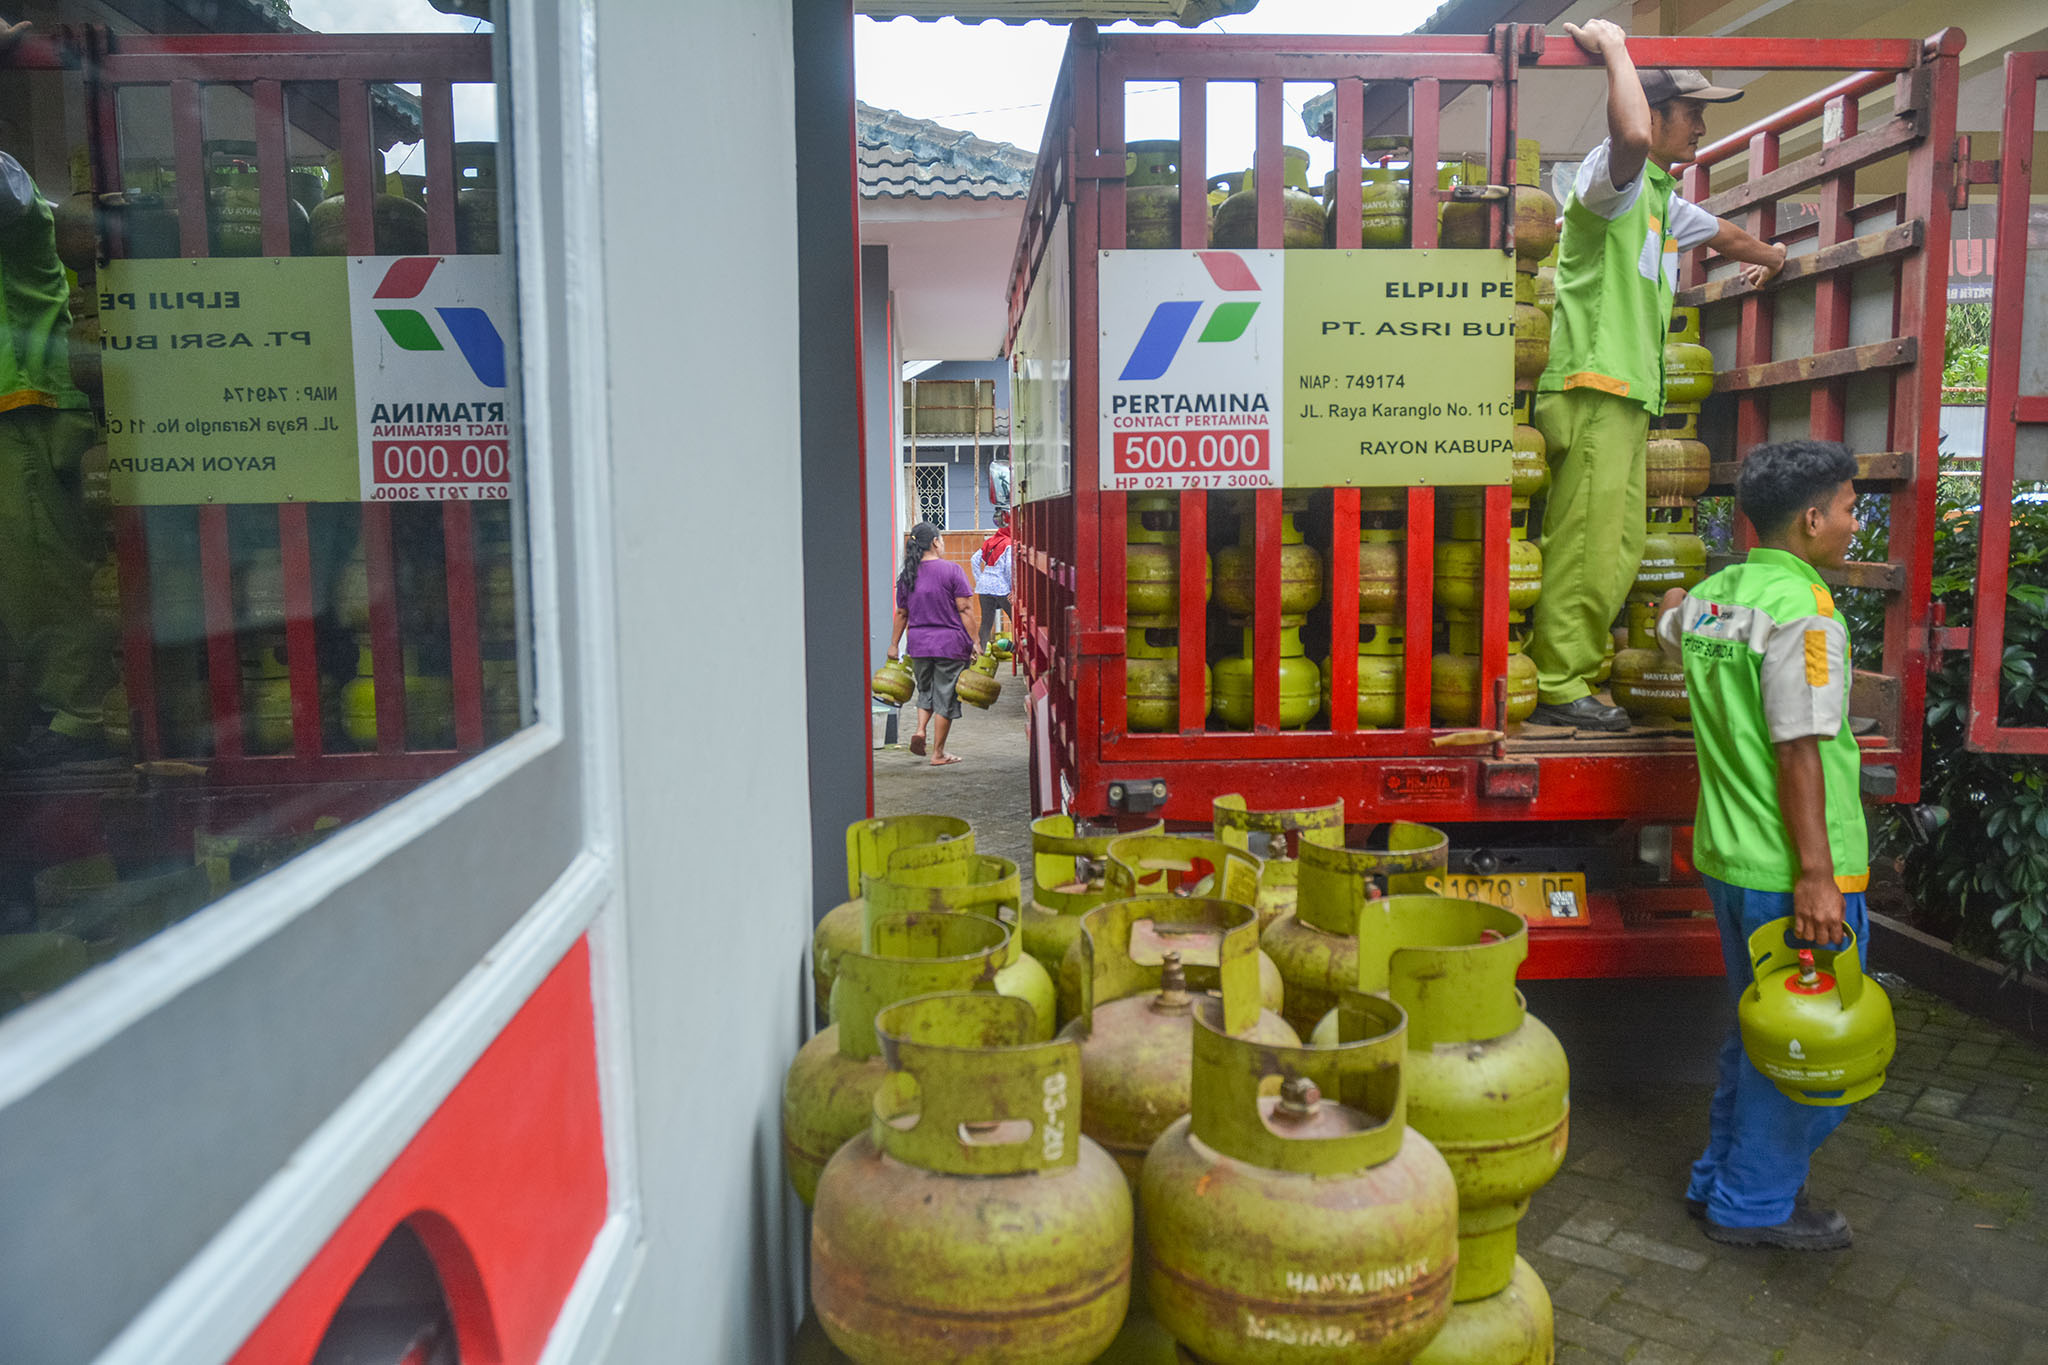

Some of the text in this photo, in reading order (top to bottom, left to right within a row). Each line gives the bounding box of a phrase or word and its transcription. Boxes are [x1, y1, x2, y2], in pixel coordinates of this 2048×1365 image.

[1386, 282, 1513, 298] ELPIJI PE
[1322, 321, 1365, 336] PT.
[1376, 322, 1450, 336] ASRI
[1300, 375, 1331, 389] NIAP
[1345, 375, 1405, 389] 749174
[1112, 393, 1270, 414] PERTAMINA
[1300, 404, 1324, 418] JL.
[1329, 404, 1367, 421] Raya
[1372, 403, 1441, 420] Karanglo
[1447, 403, 1472, 416] No.
[1478, 403, 1492, 416] 11
[1113, 414, 1269, 428] CONTACT PERTAMINA
[1125, 434, 1260, 469] 500.000
[1361, 439, 1513, 455] RAYON KABUPA
[1116, 474, 1268, 488] HP 021 7917 3000
